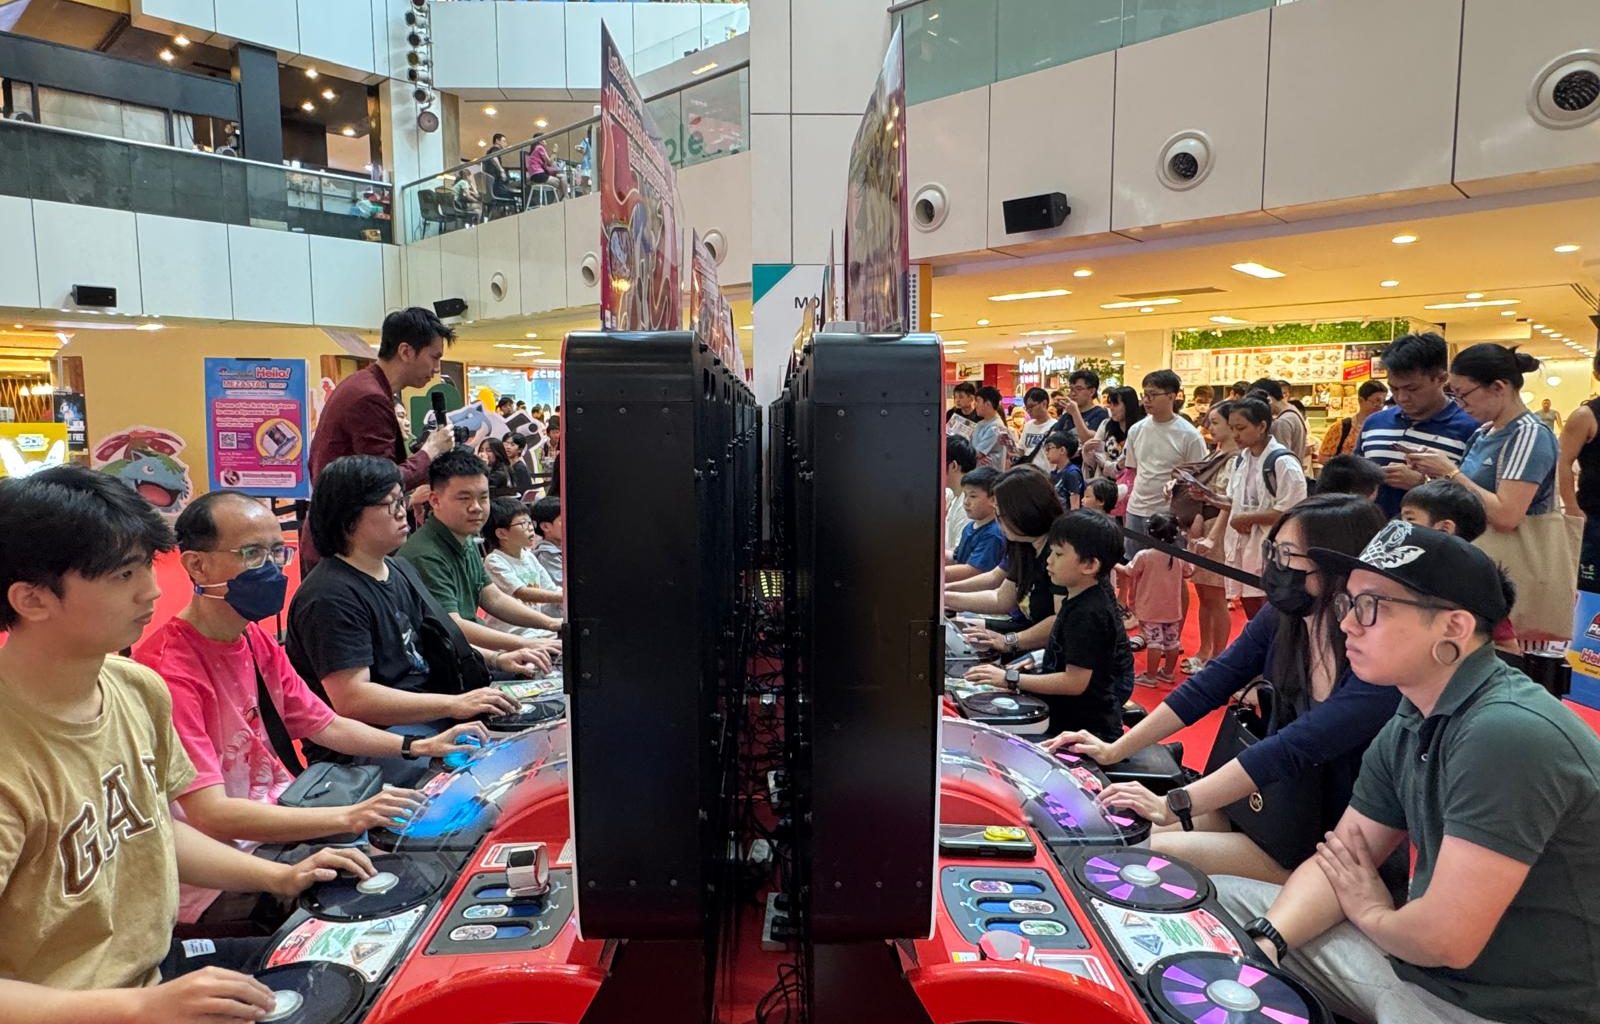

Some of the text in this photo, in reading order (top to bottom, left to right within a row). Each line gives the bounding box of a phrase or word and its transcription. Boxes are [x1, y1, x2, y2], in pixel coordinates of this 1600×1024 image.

[256, 367, 291, 378] Hello!
[1019, 355, 1076, 375] Food Dynasty
